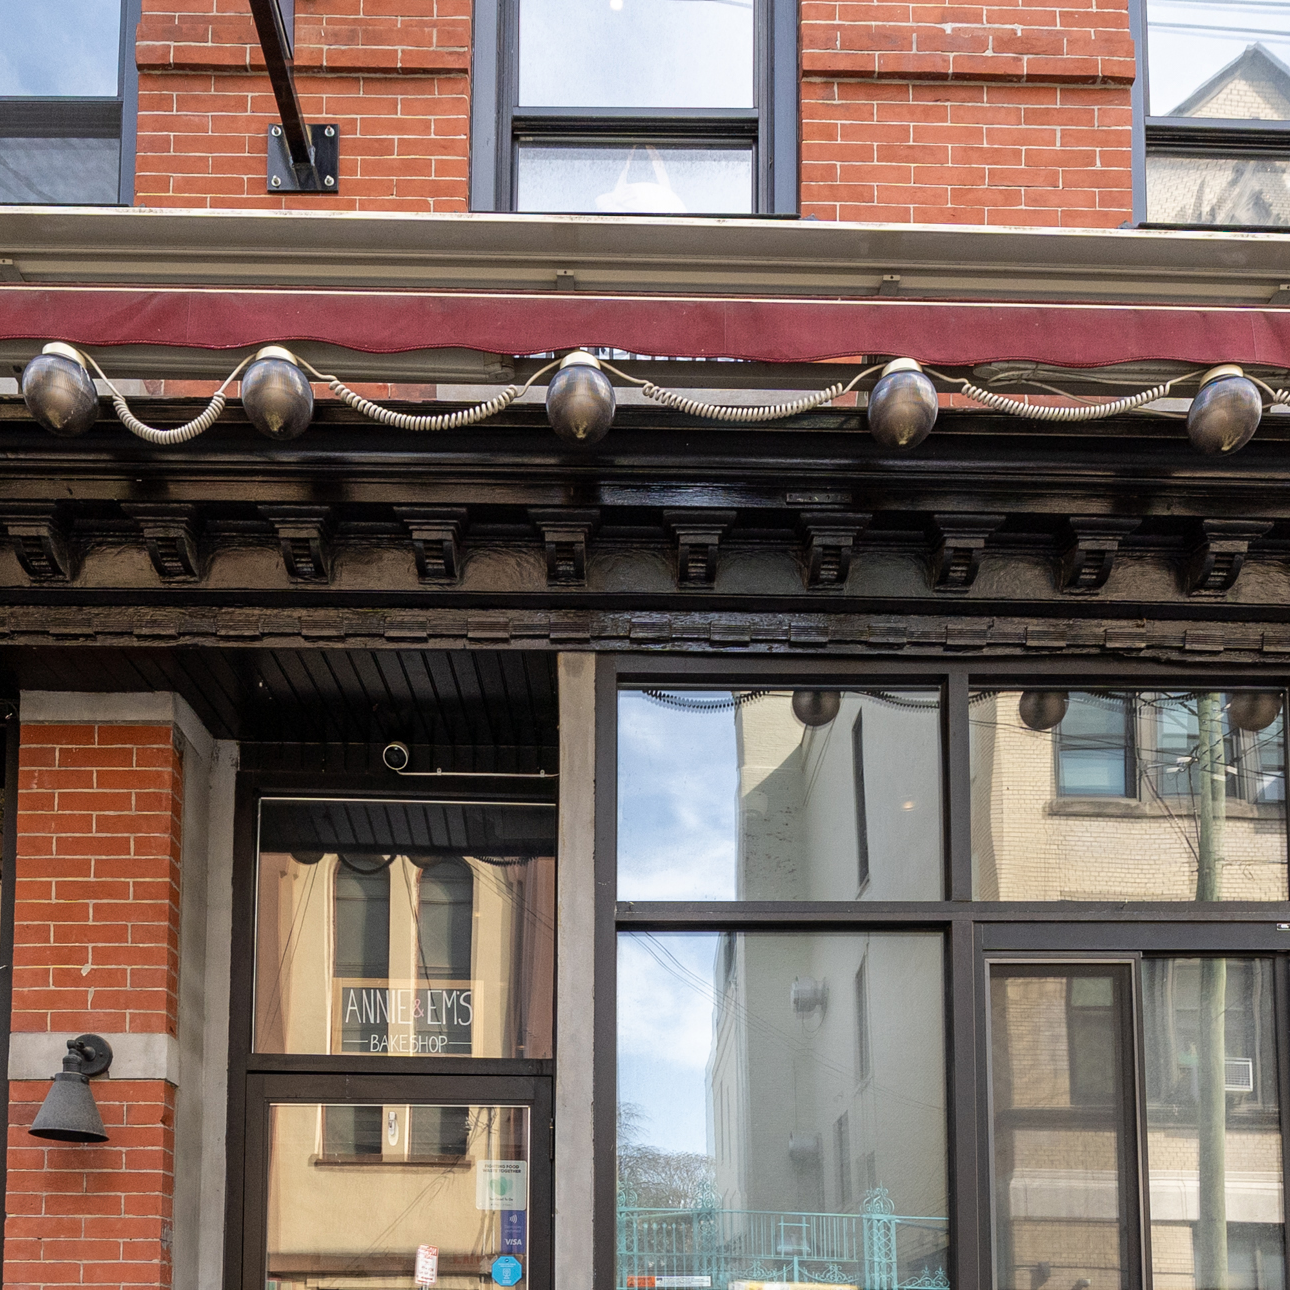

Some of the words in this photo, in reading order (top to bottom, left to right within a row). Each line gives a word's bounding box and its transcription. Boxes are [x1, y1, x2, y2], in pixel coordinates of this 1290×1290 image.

[345, 988, 413, 1025] ANNIE
[412, 998, 425, 1018] &
[427, 989, 472, 1026] EM'S
[370, 1034, 448, 1053] BAKESHOP
